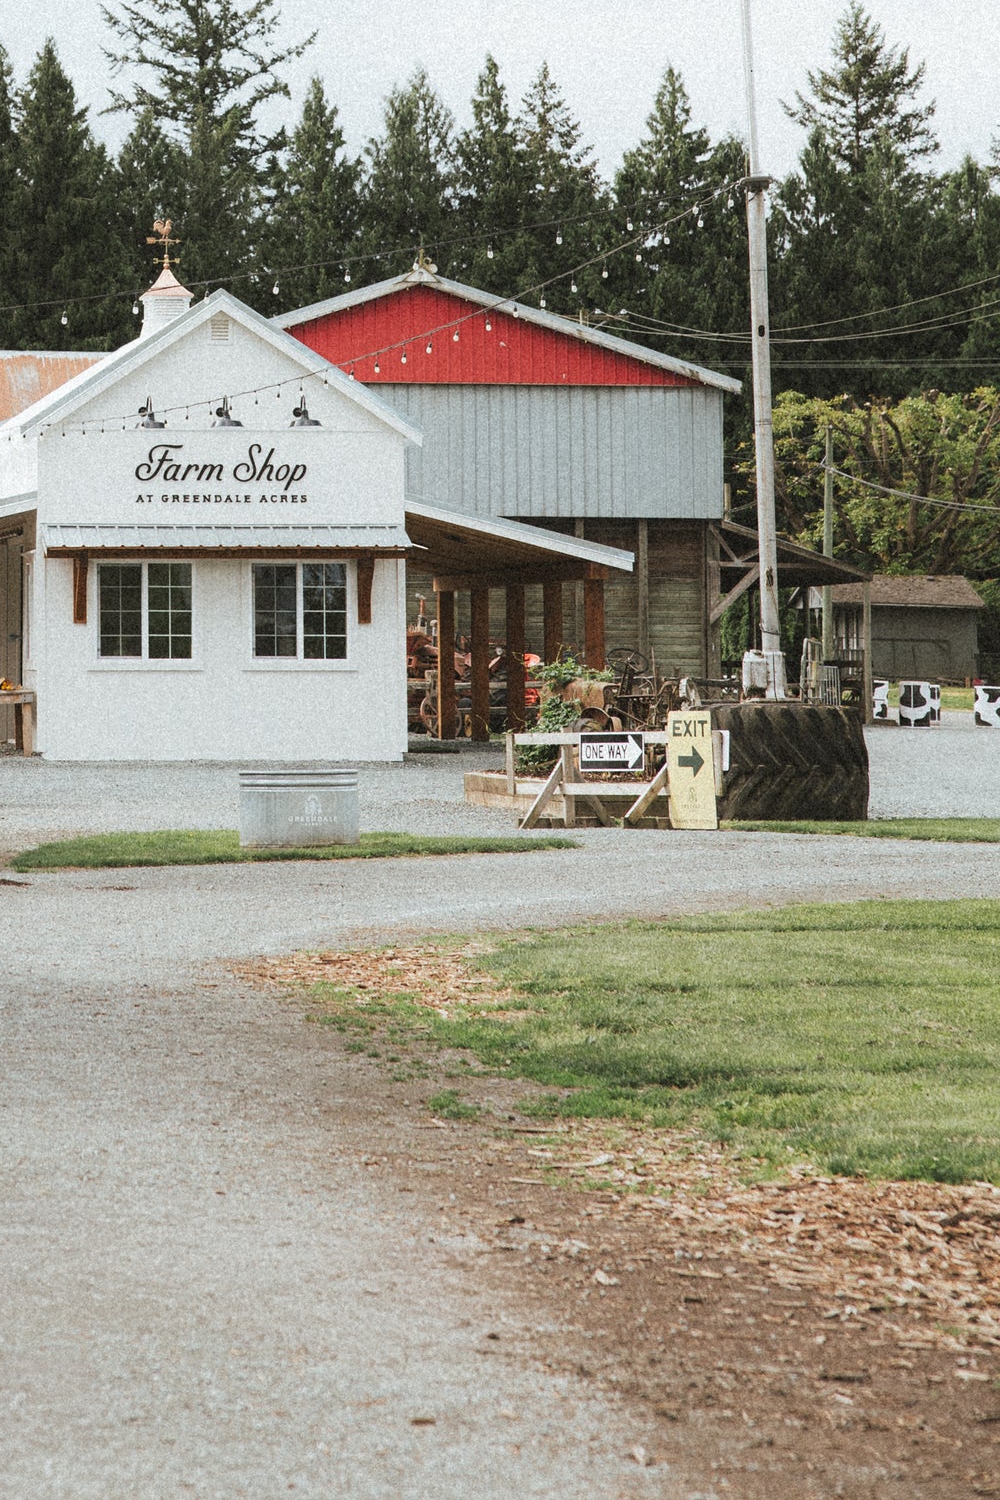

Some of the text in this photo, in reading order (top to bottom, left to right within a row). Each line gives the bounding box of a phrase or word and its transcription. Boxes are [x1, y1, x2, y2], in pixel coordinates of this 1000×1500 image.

[135, 443, 308, 491] Farm Shop
[136, 494, 308, 504] AT GREENDALE ACRES
[672, 719, 708, 737] EXIT
[585, 744, 628, 759] ONE WAY
